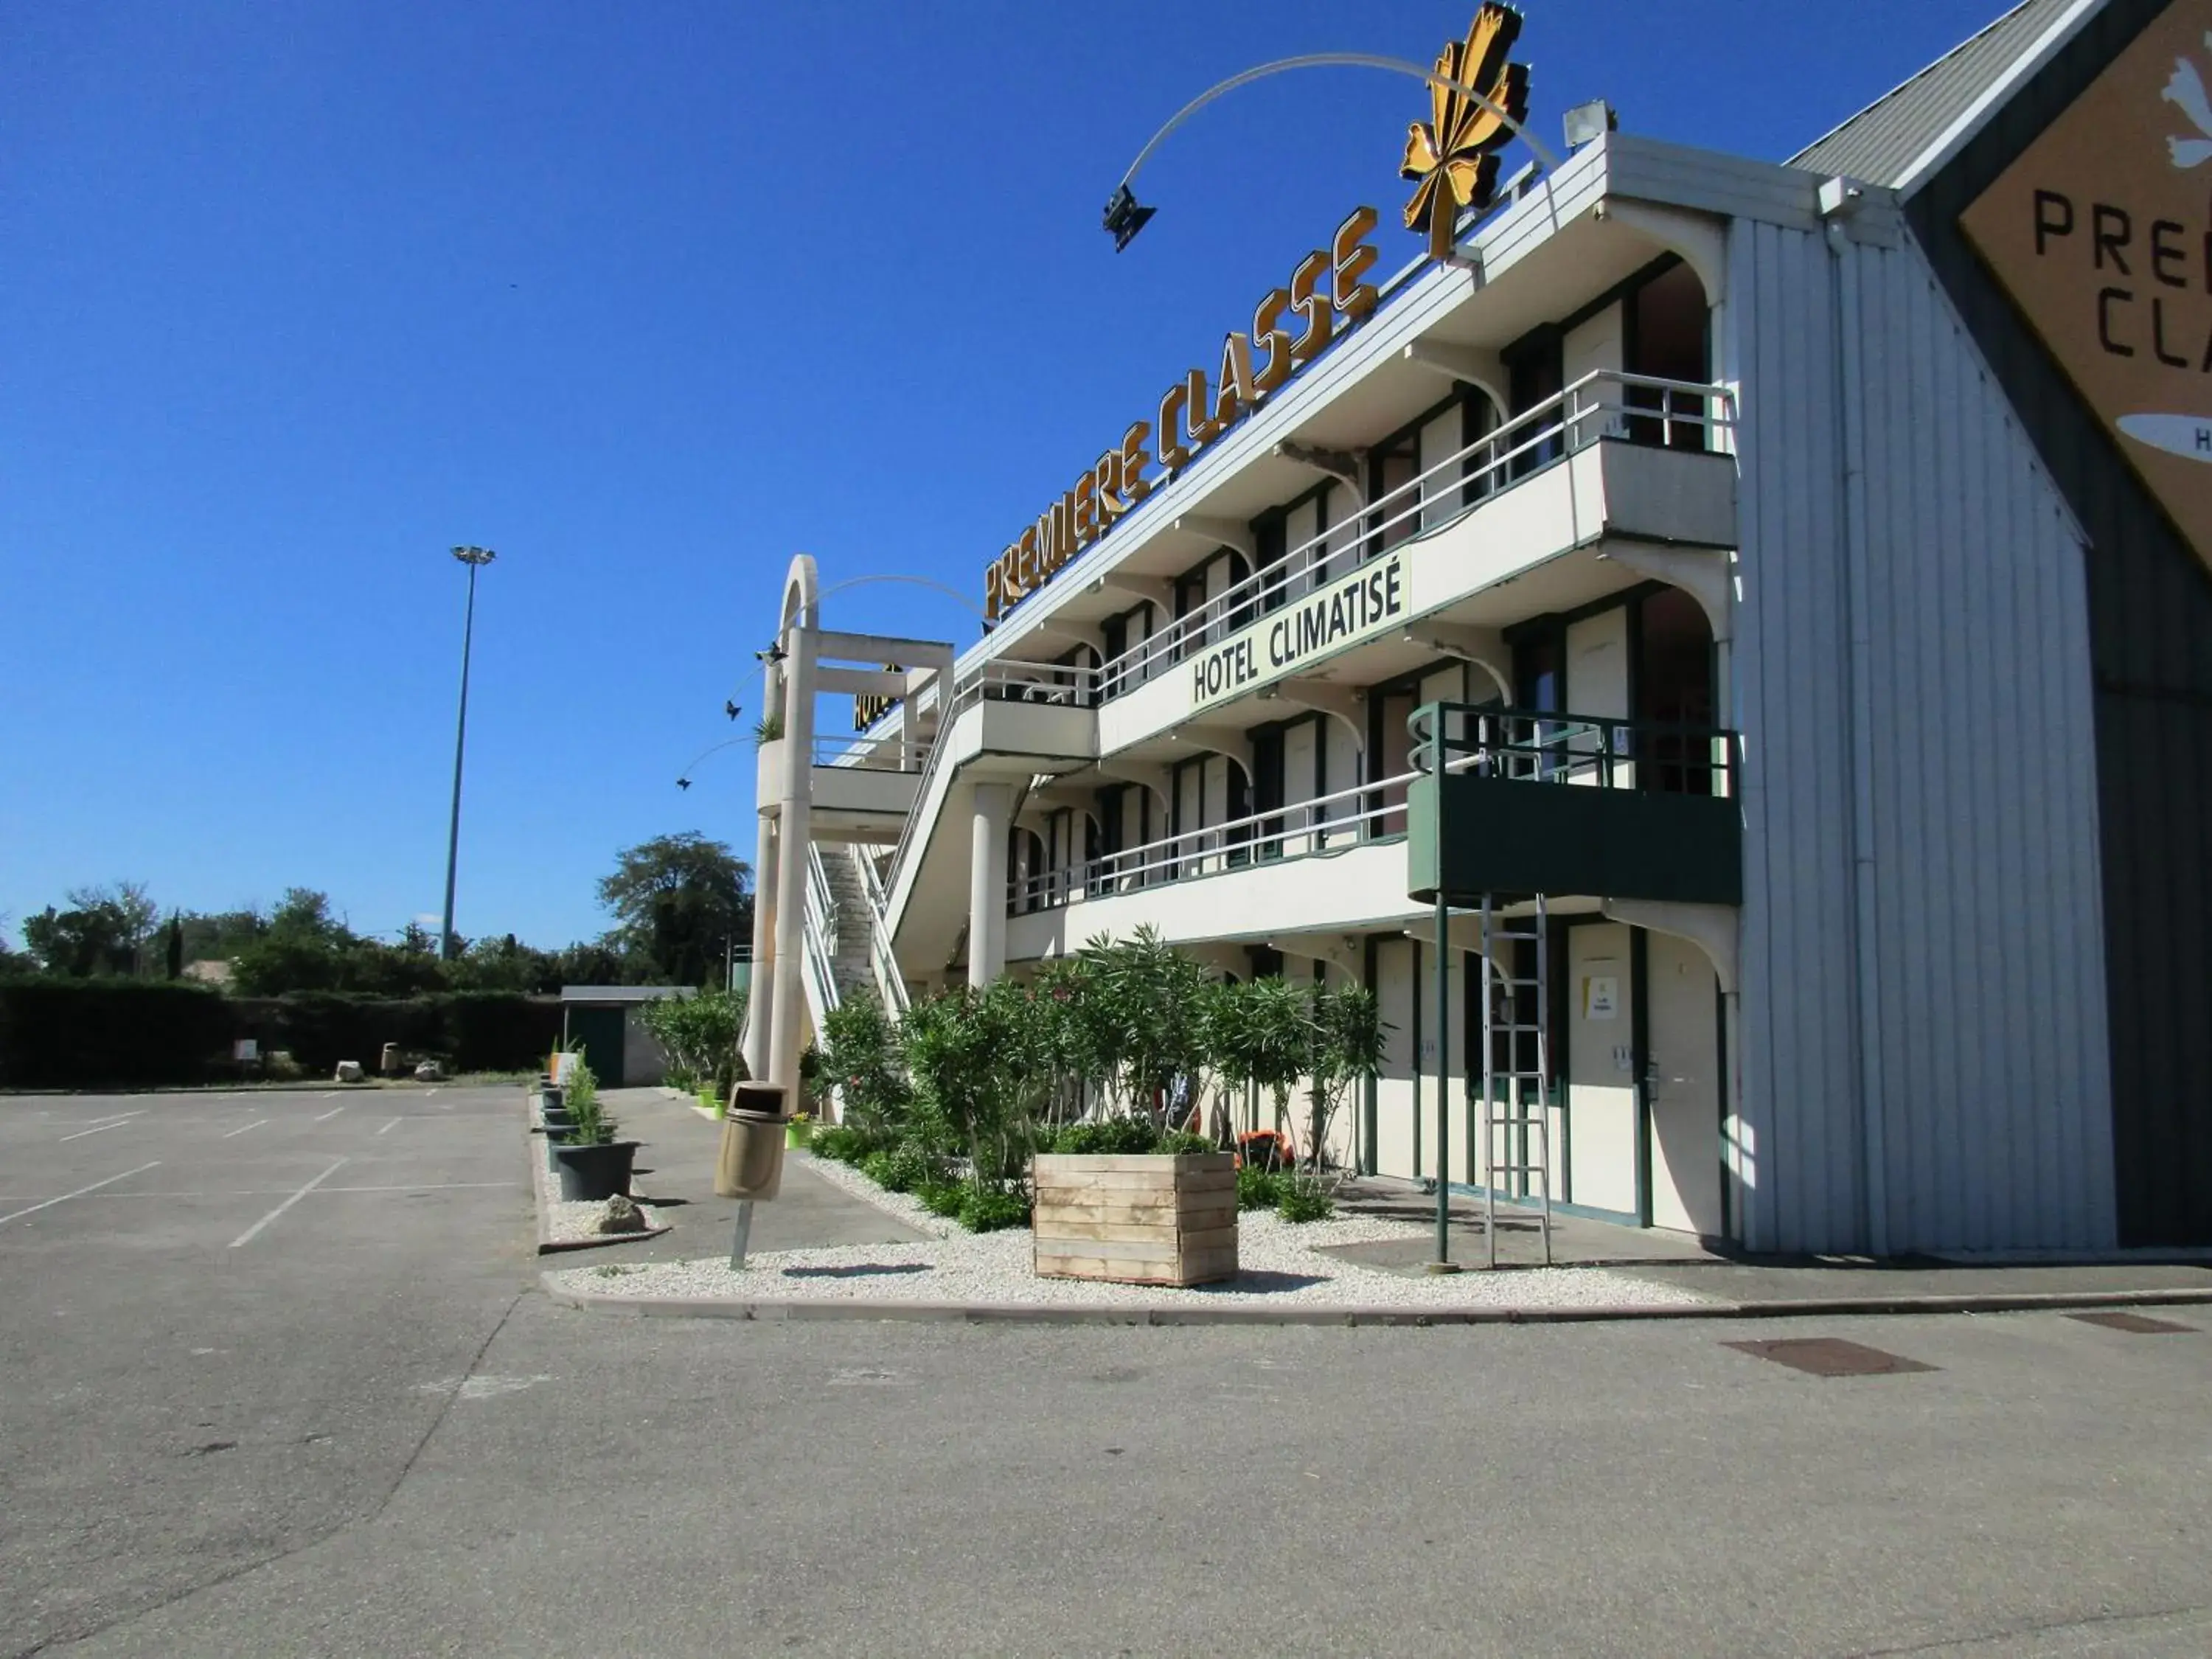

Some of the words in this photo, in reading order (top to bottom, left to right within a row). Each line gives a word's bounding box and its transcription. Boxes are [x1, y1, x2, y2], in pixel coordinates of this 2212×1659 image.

[2034, 188, 2212, 295] PRE
[984, 419, 1152, 621] PREMIERE
[1158, 206, 1379, 470] CLASSE
[1194, 637, 1258, 703] HOTEL
[1268, 555, 1401, 667] CLIMATISÉ
